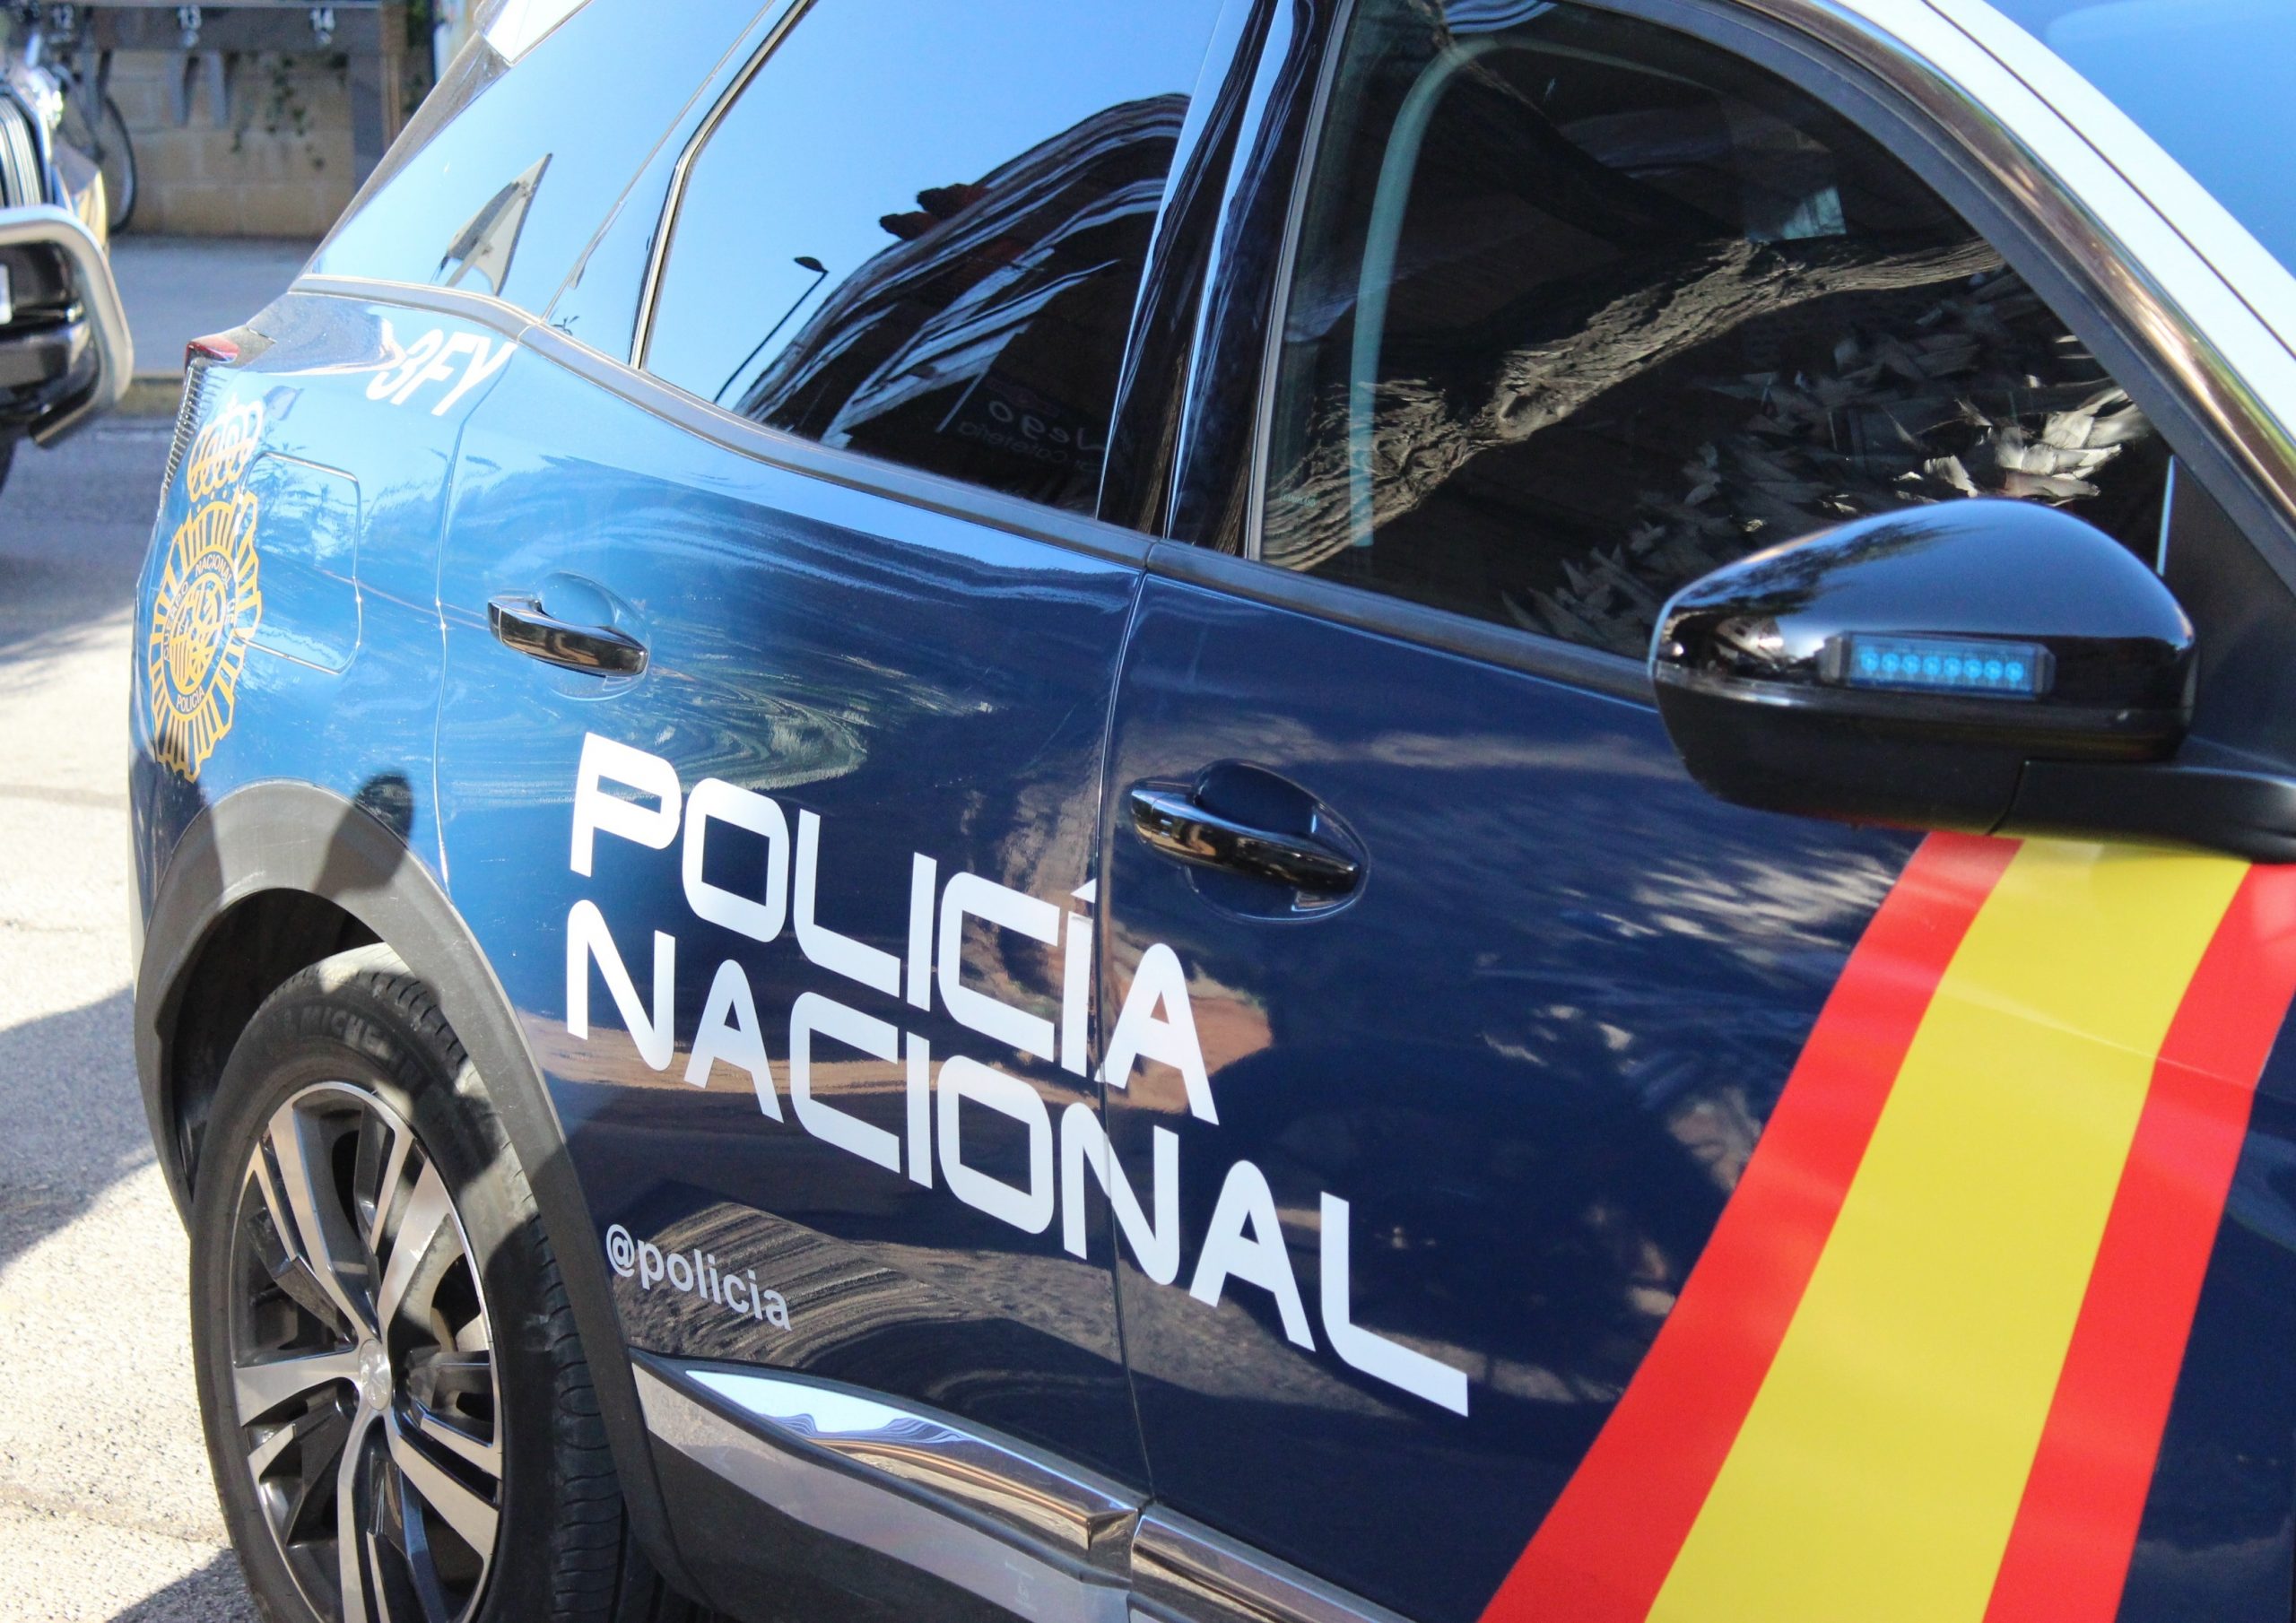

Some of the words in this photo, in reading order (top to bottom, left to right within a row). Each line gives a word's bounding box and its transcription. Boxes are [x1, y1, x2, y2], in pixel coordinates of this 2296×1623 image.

[178, 4, 201, 30] 13
[310, 7, 335, 31] 14
[366, 328, 518, 416] 3FY
[196, 554, 232, 590] NACIONAL
[570, 731, 1220, 1126] POLICÍA
[566, 899, 1469, 1418] NACIONAL
[605, 1223, 793, 1332] @policia
